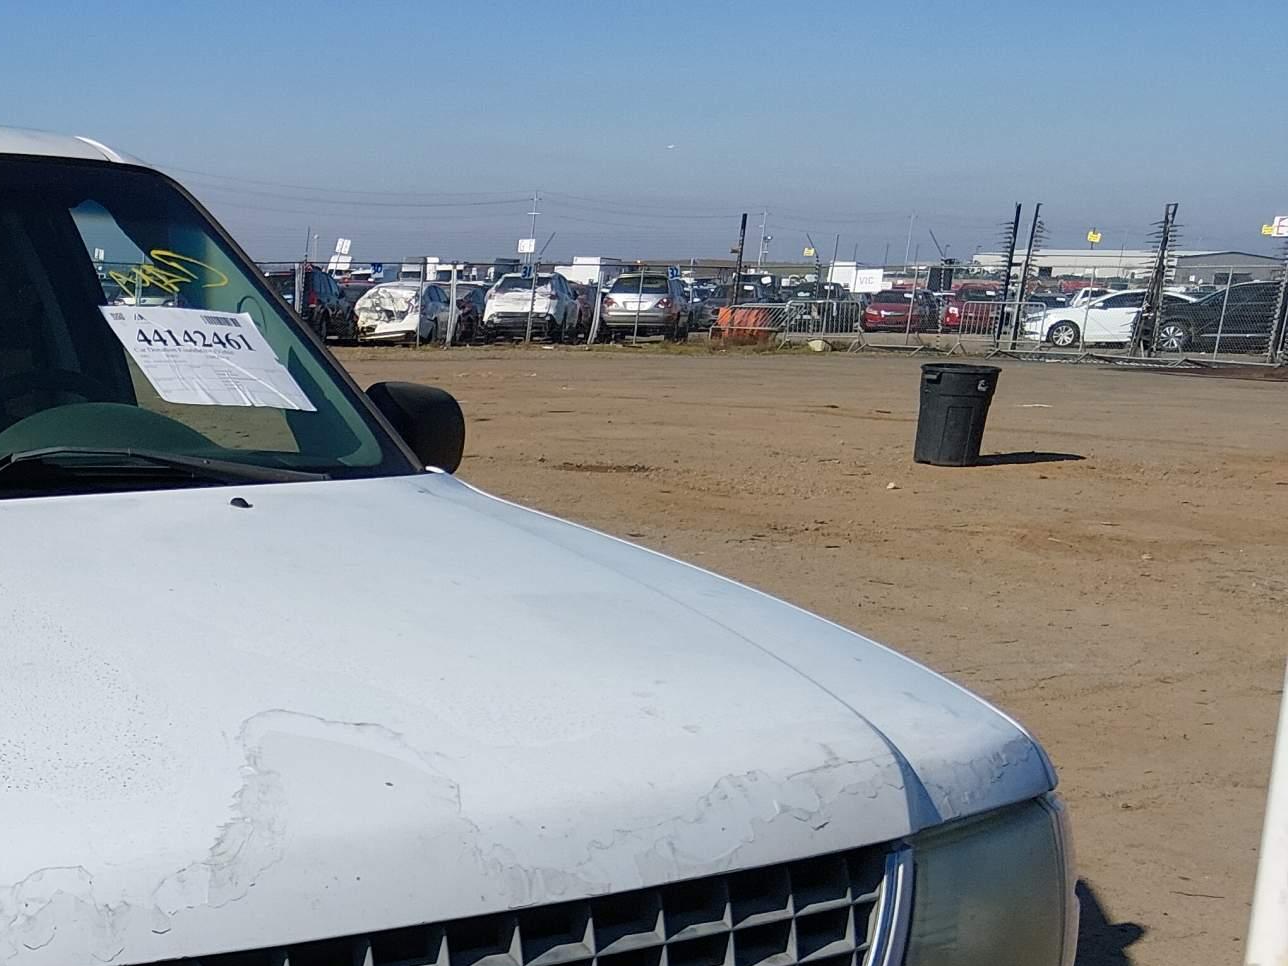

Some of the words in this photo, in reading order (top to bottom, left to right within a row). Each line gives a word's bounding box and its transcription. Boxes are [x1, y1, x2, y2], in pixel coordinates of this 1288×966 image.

[521, 265, 532, 278] 31
[669, 266, 681, 279] 32
[136, 328, 256, 351] 44142461
